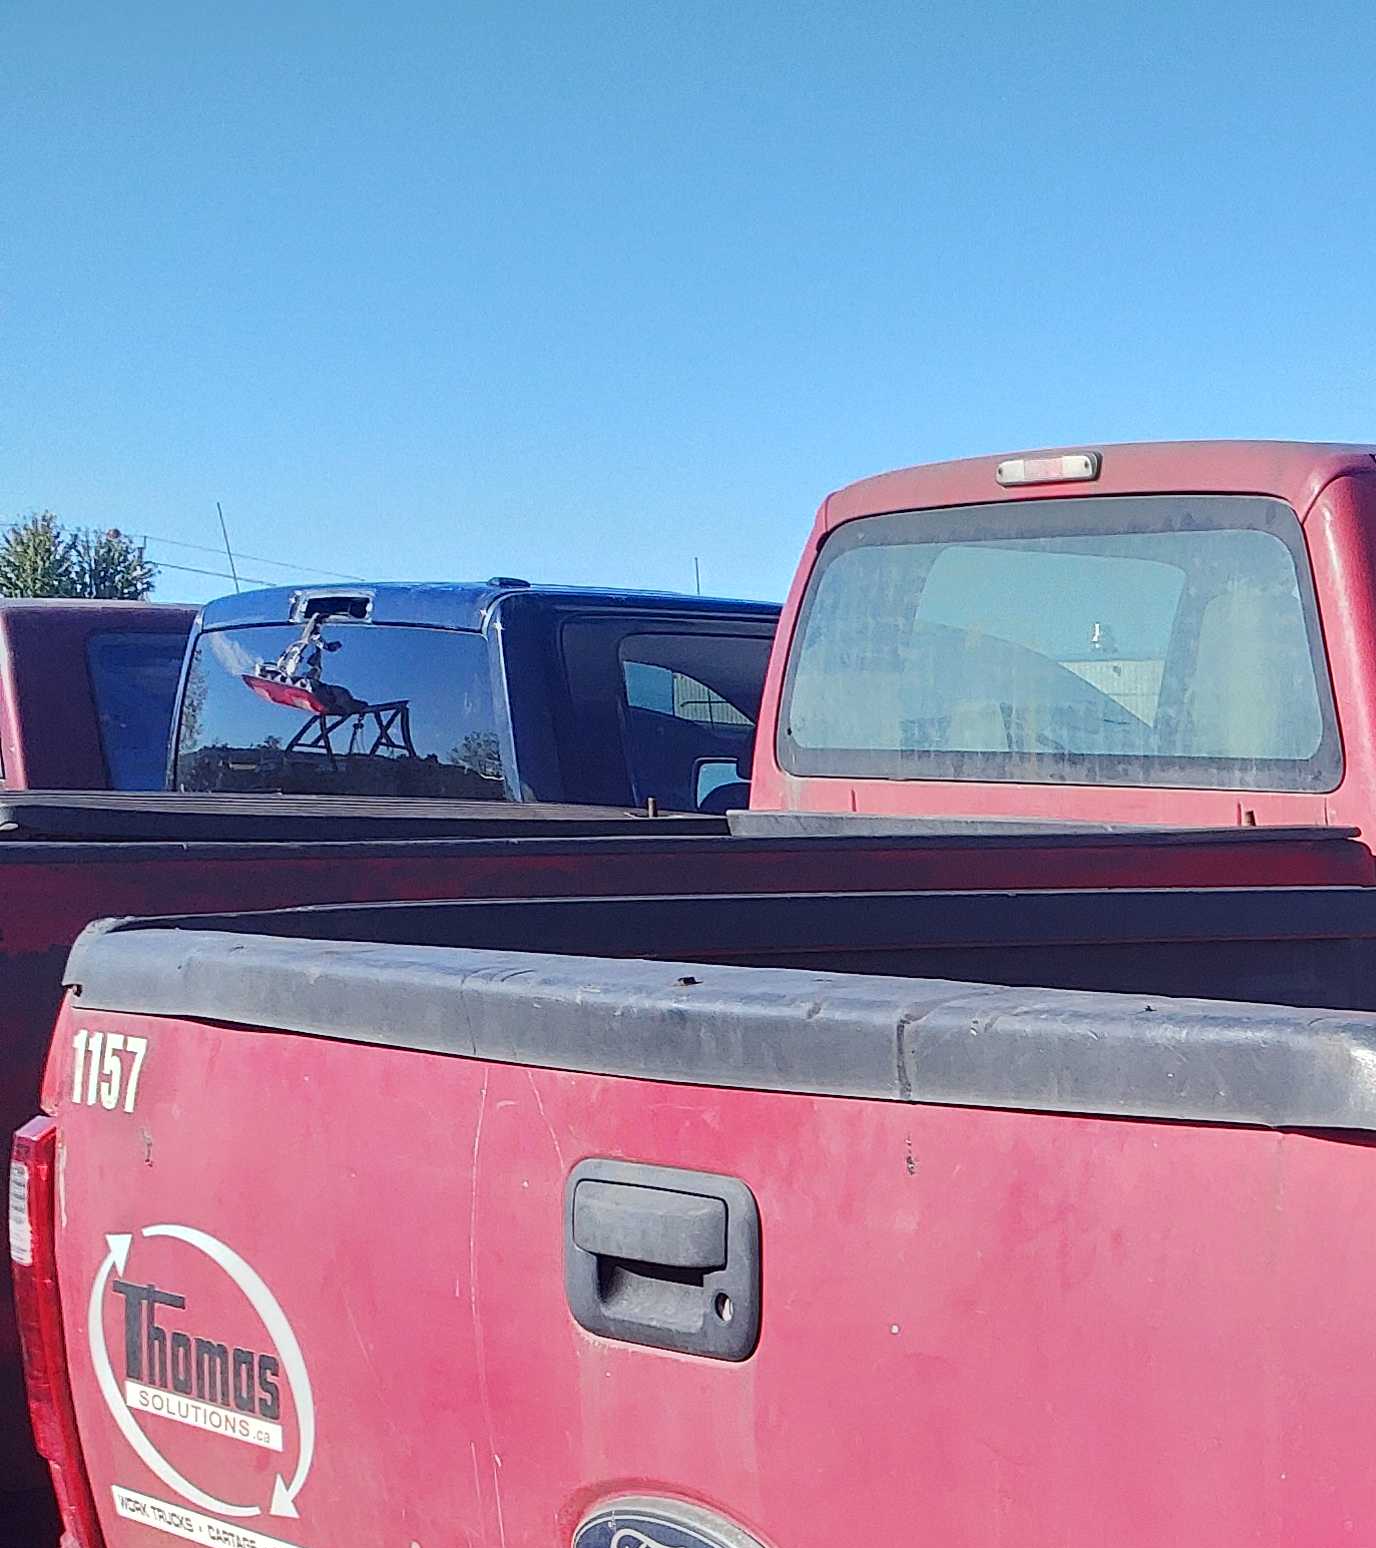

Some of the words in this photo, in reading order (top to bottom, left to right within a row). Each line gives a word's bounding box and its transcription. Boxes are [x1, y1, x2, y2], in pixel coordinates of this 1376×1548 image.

[72, 1028, 148, 1114] 1157
[112, 1279, 281, 1421] Thomas
[118, 1494, 148, 1514] WORK
[150, 1504, 194, 1533] TRUCKS
